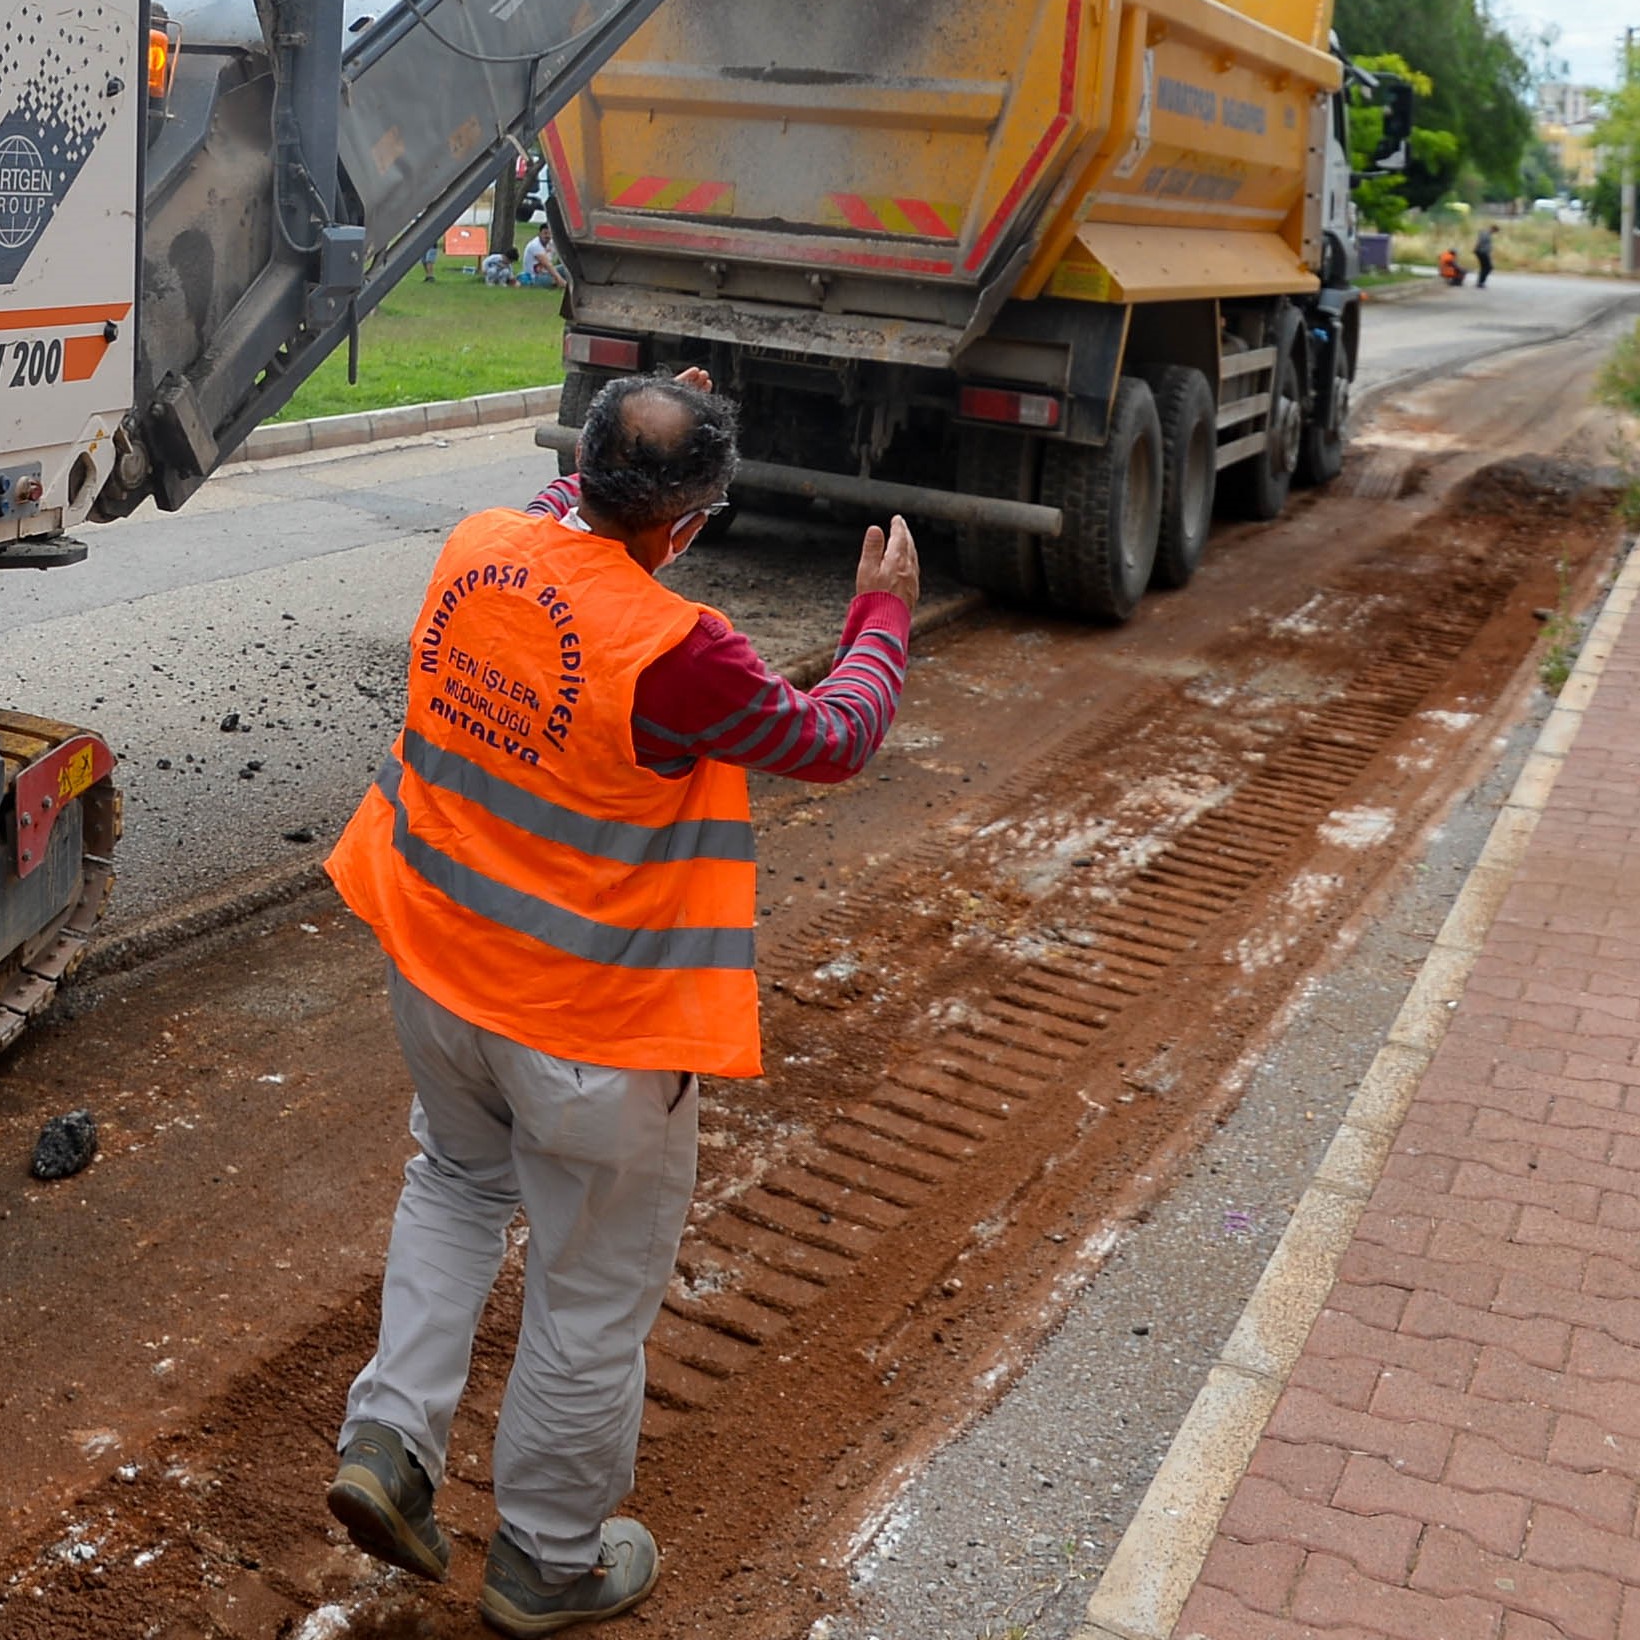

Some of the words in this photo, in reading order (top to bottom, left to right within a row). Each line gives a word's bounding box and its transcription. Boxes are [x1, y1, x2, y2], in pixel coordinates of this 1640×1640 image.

[10, 339, 61, 388] 200
[420, 564, 529, 674] MURATPAŞA
[448, 647, 479, 678] FEN
[430, 697, 539, 766] ANTALYA
[444, 676, 531, 737] MÜDÜRLÜĞÜ
